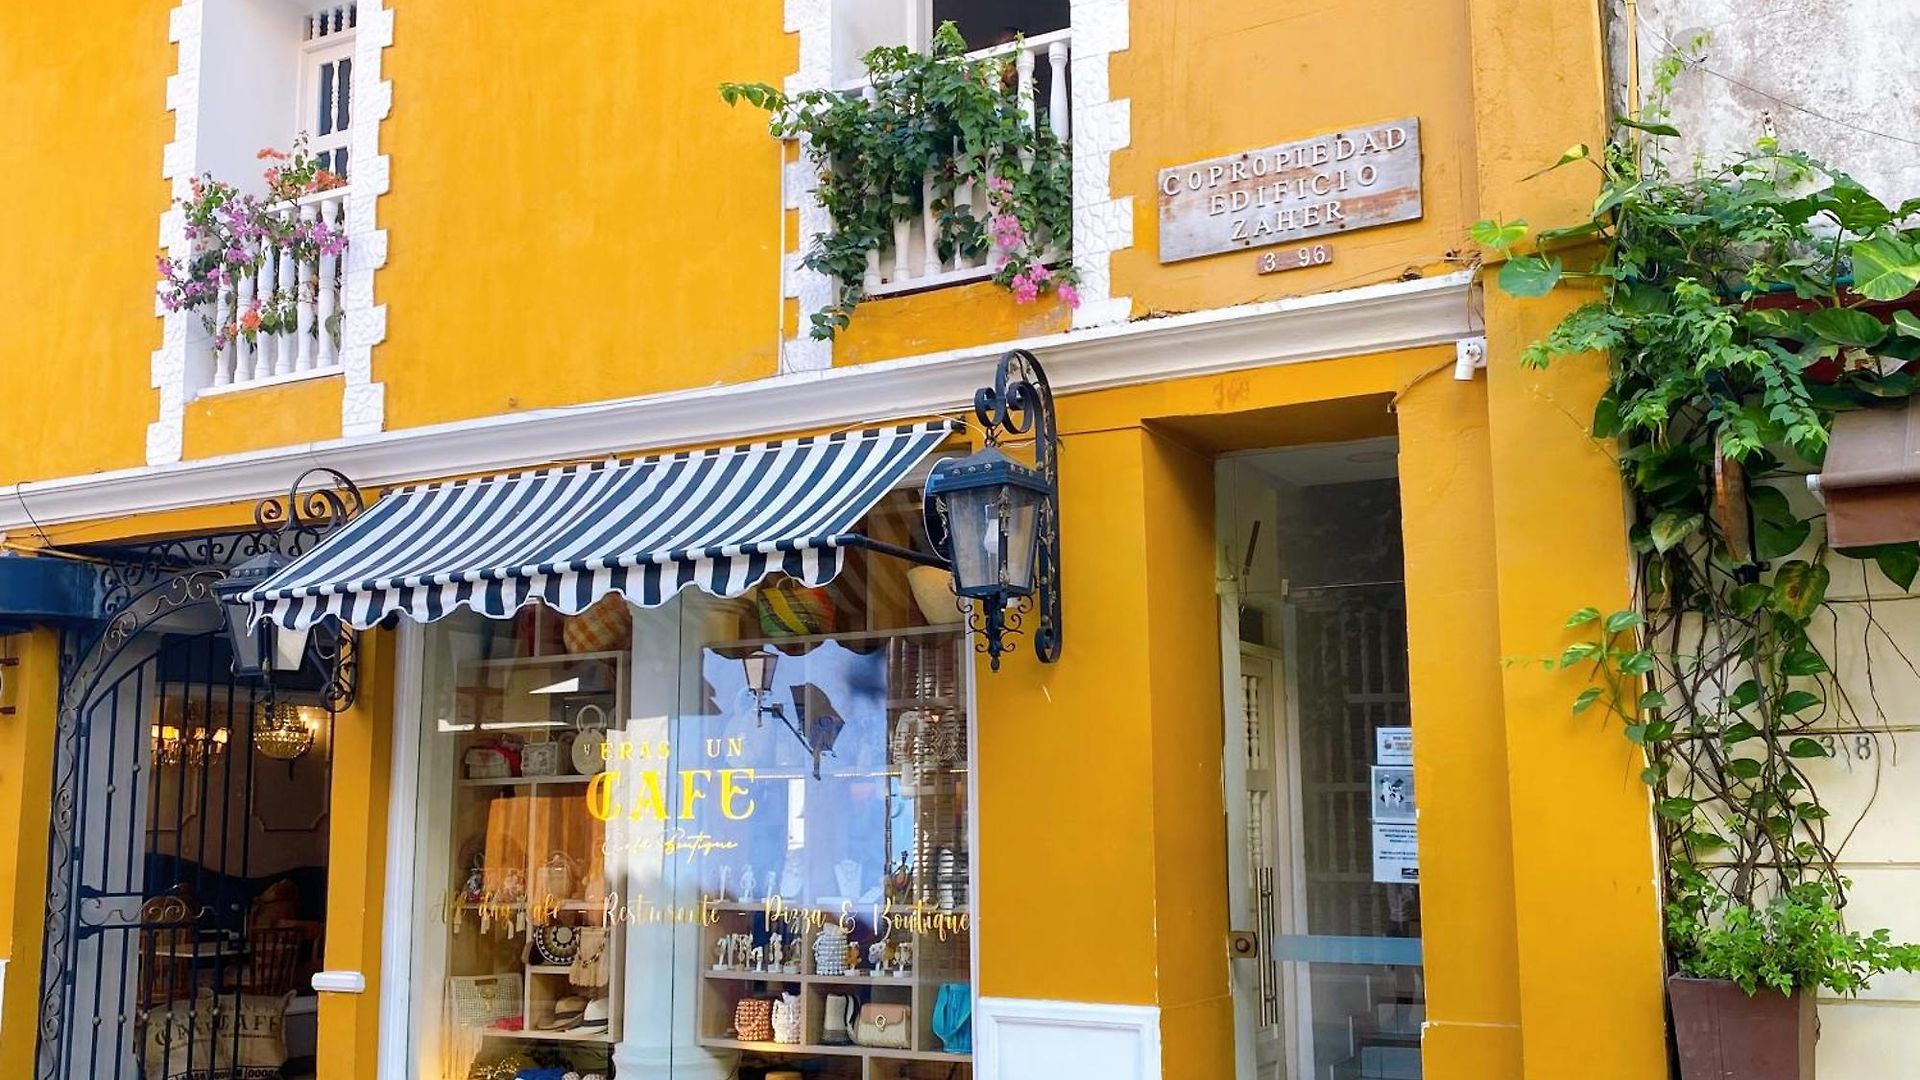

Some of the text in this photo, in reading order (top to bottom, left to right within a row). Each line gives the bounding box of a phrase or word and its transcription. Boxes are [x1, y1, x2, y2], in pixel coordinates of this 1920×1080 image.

[1163, 127, 1408, 197] COPROPIEDAD
[1208, 164, 1379, 216] EDIFICIO
[1231, 200, 1346, 242] ZAHER
[706, 738, 744, 758] UN
[586, 768, 756, 821] CAFE
[764, 894, 827, 933] Pizza
[839, 900, 859, 934] &
[873, 896, 971, 943] Boutique
